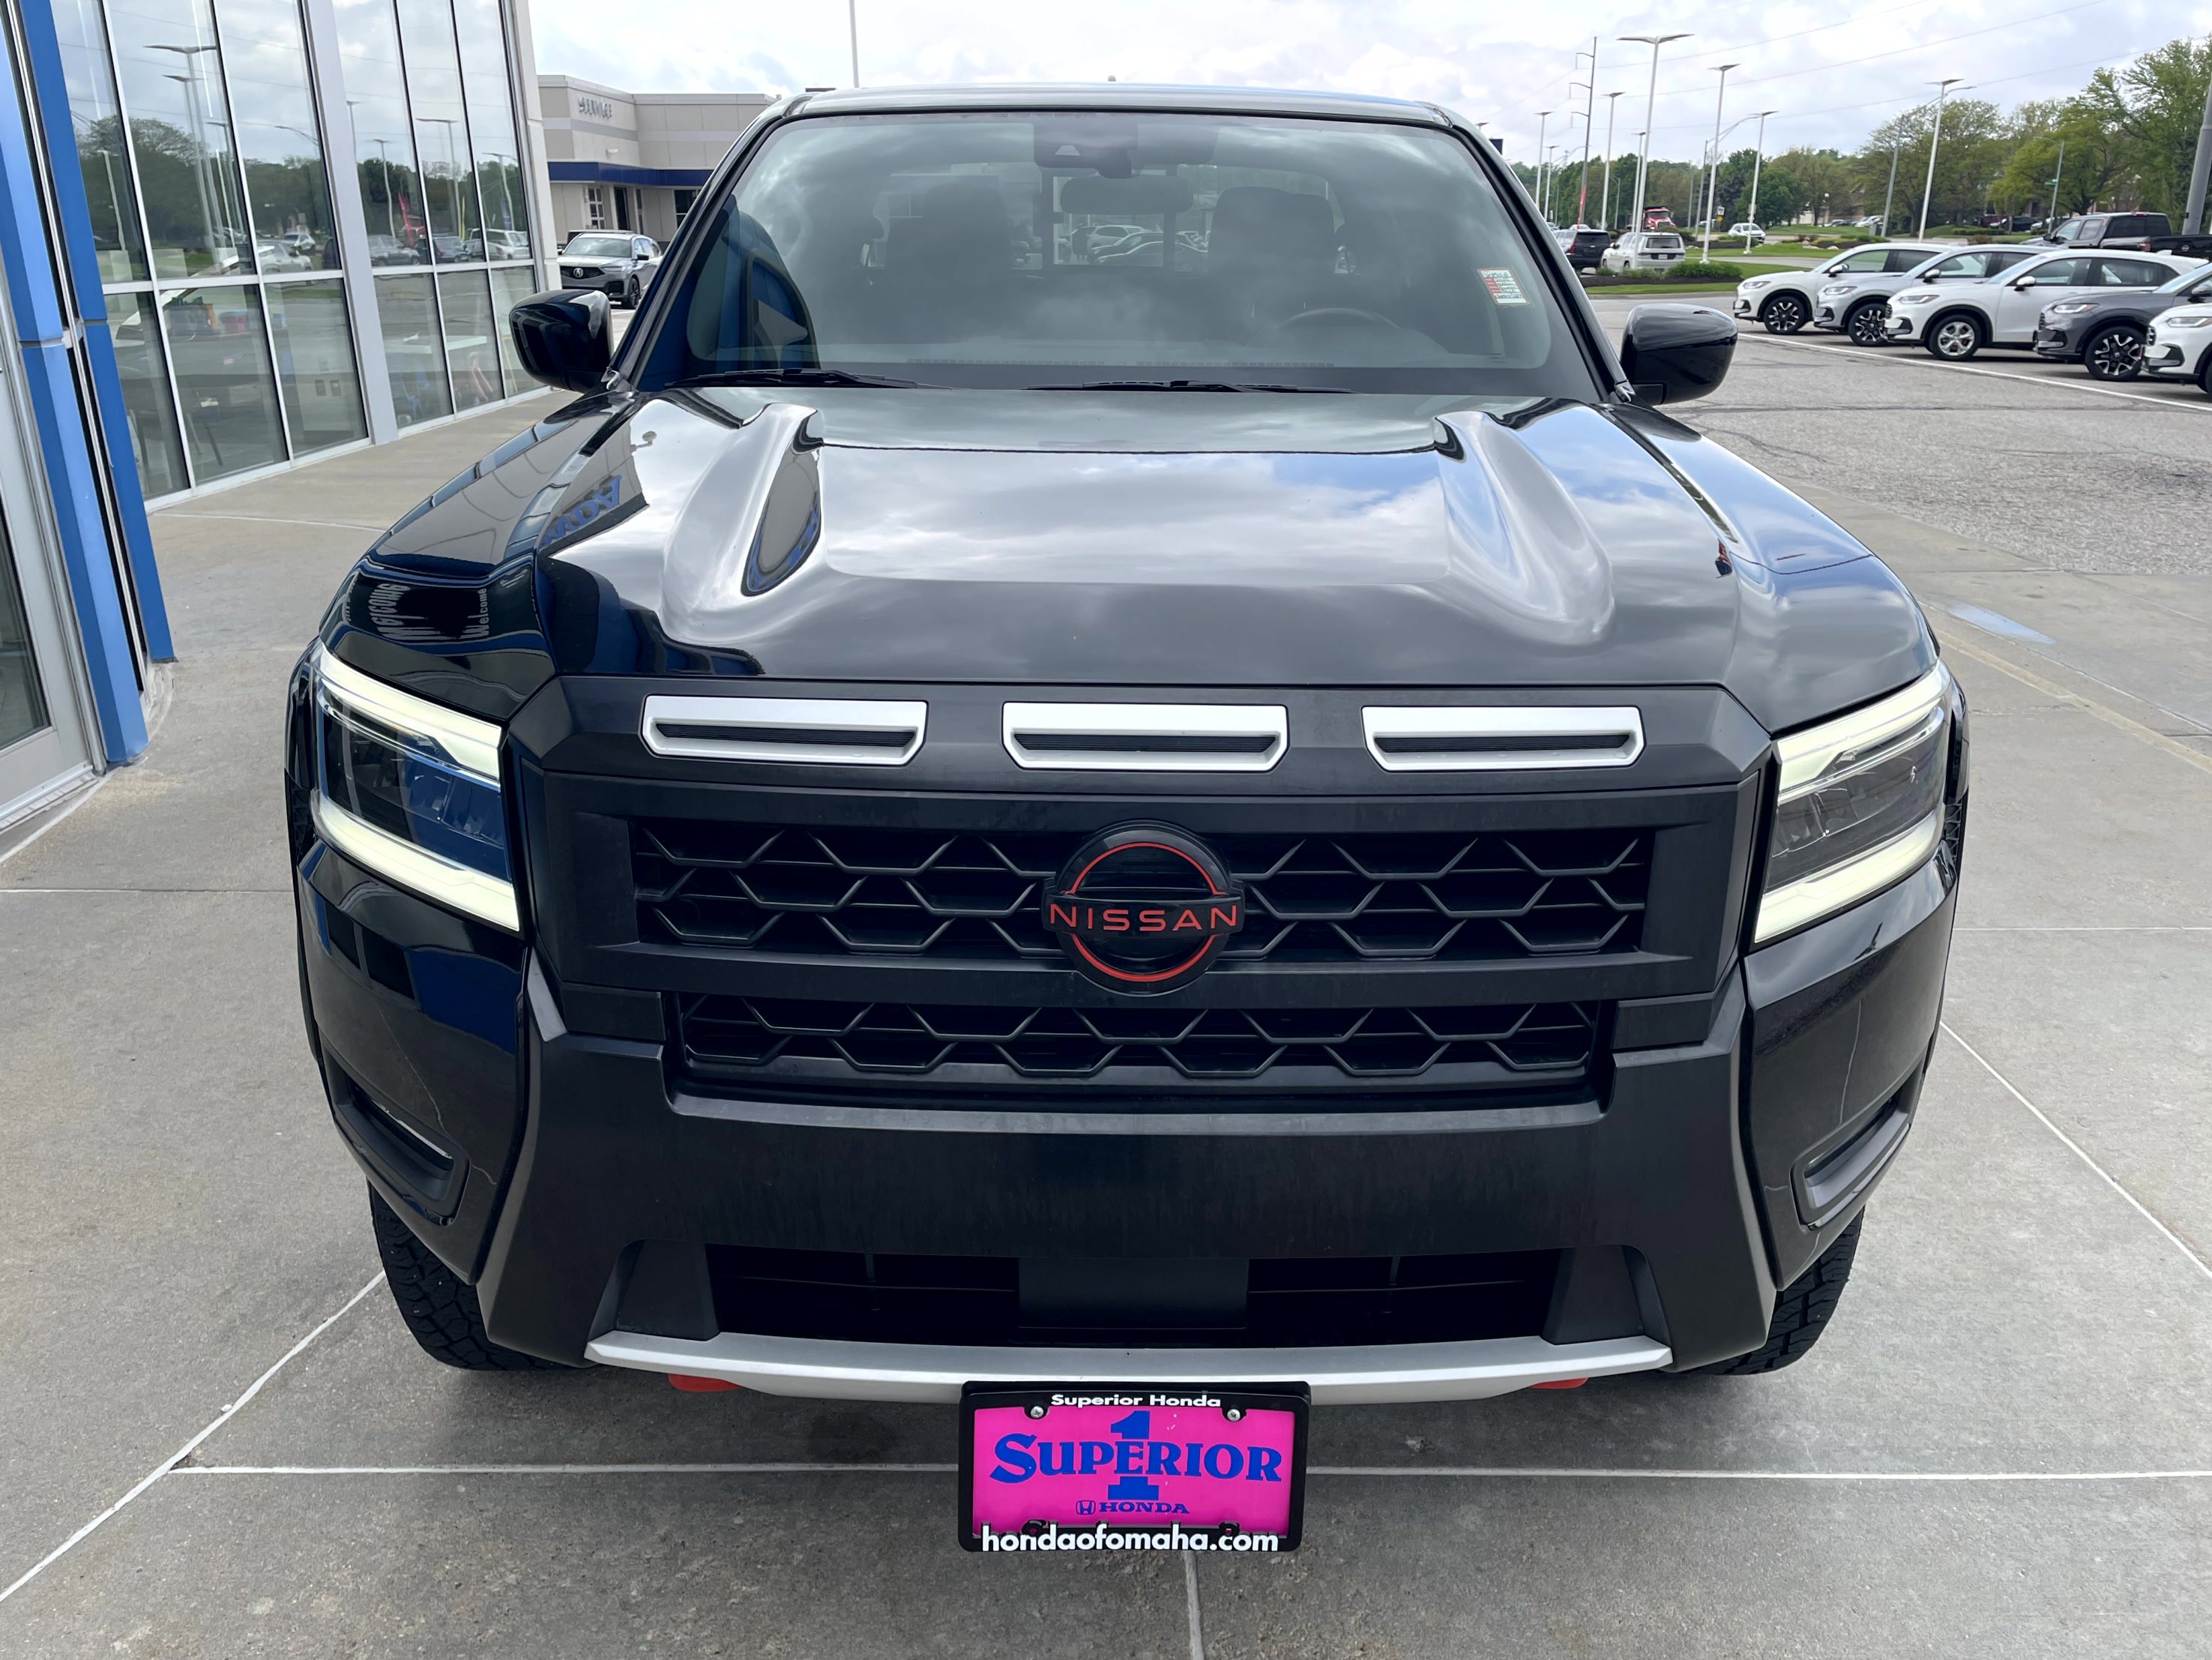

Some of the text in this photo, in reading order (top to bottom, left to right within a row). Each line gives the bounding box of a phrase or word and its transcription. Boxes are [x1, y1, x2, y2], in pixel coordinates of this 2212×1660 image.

[1050, 903, 1238, 931] NISSAN
[1051, 1394, 1222, 1408] Superior Honda
[989, 1433, 1283, 1484] SUPERIOR
[1099, 1501, 1190, 1515] HONDA
[982, 1524, 1279, 1553] hondaofomaha.com
